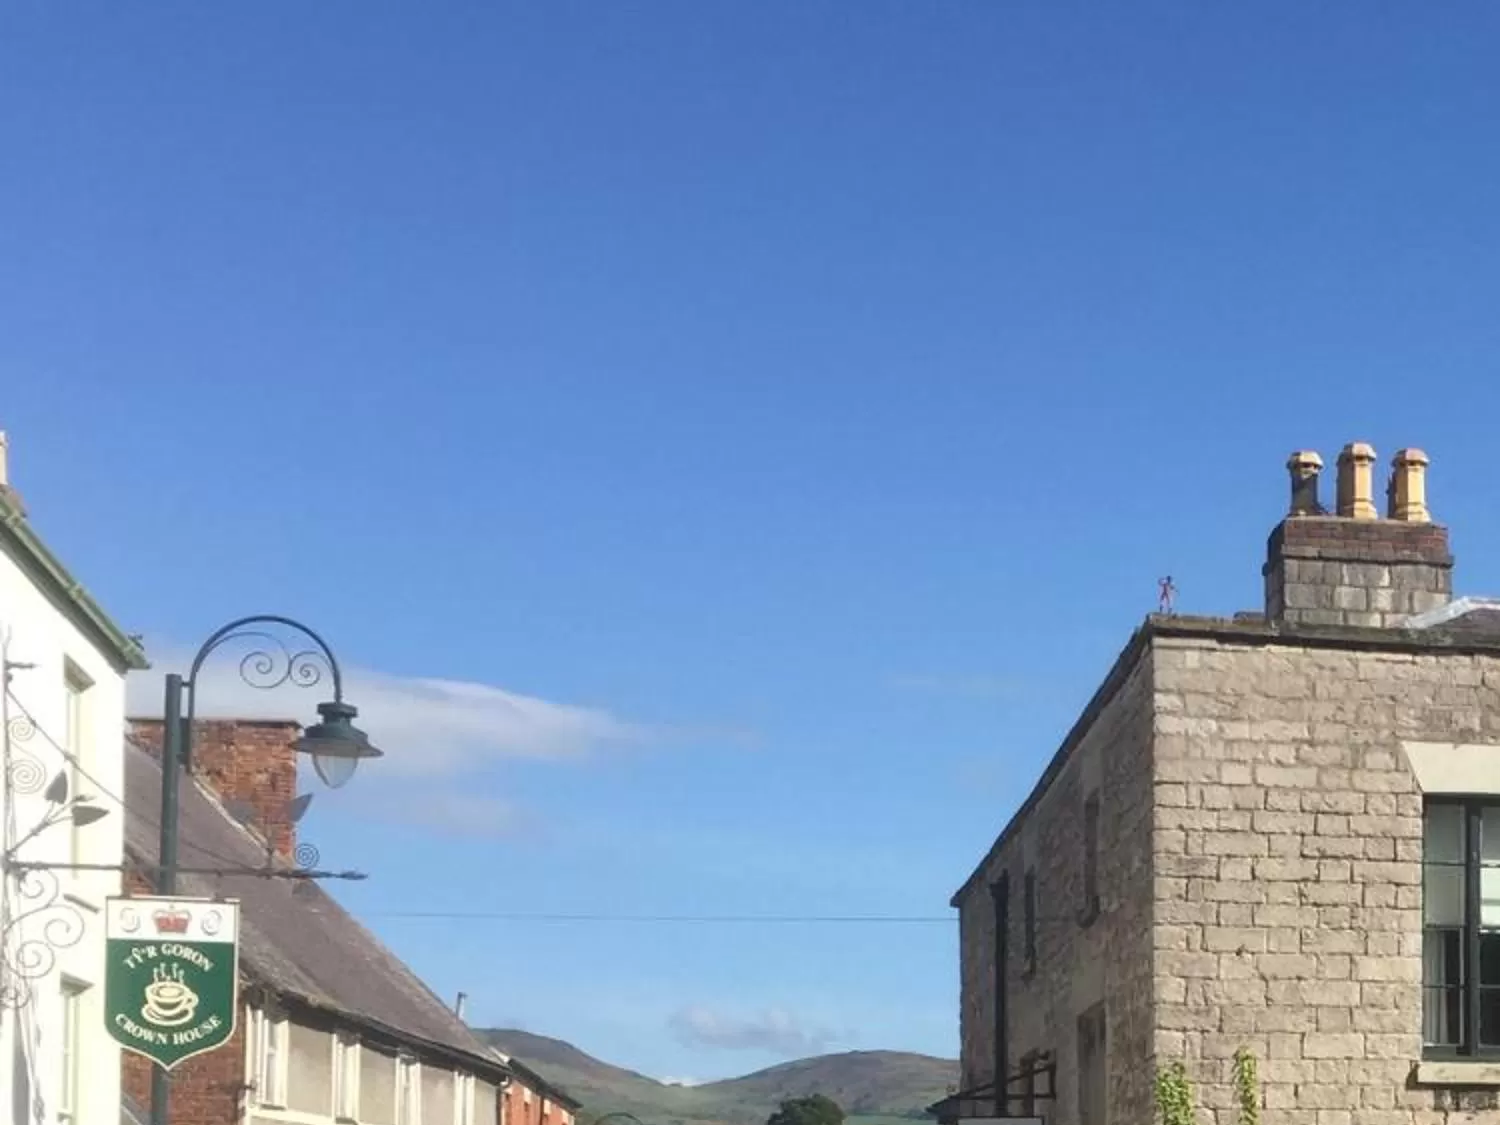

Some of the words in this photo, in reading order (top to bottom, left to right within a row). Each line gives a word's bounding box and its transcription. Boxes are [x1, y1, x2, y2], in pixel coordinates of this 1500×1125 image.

[162, 944, 214, 971] GORON
[116, 1014, 167, 1044] CROWN
[174, 1015, 221, 1044] HOUSE
